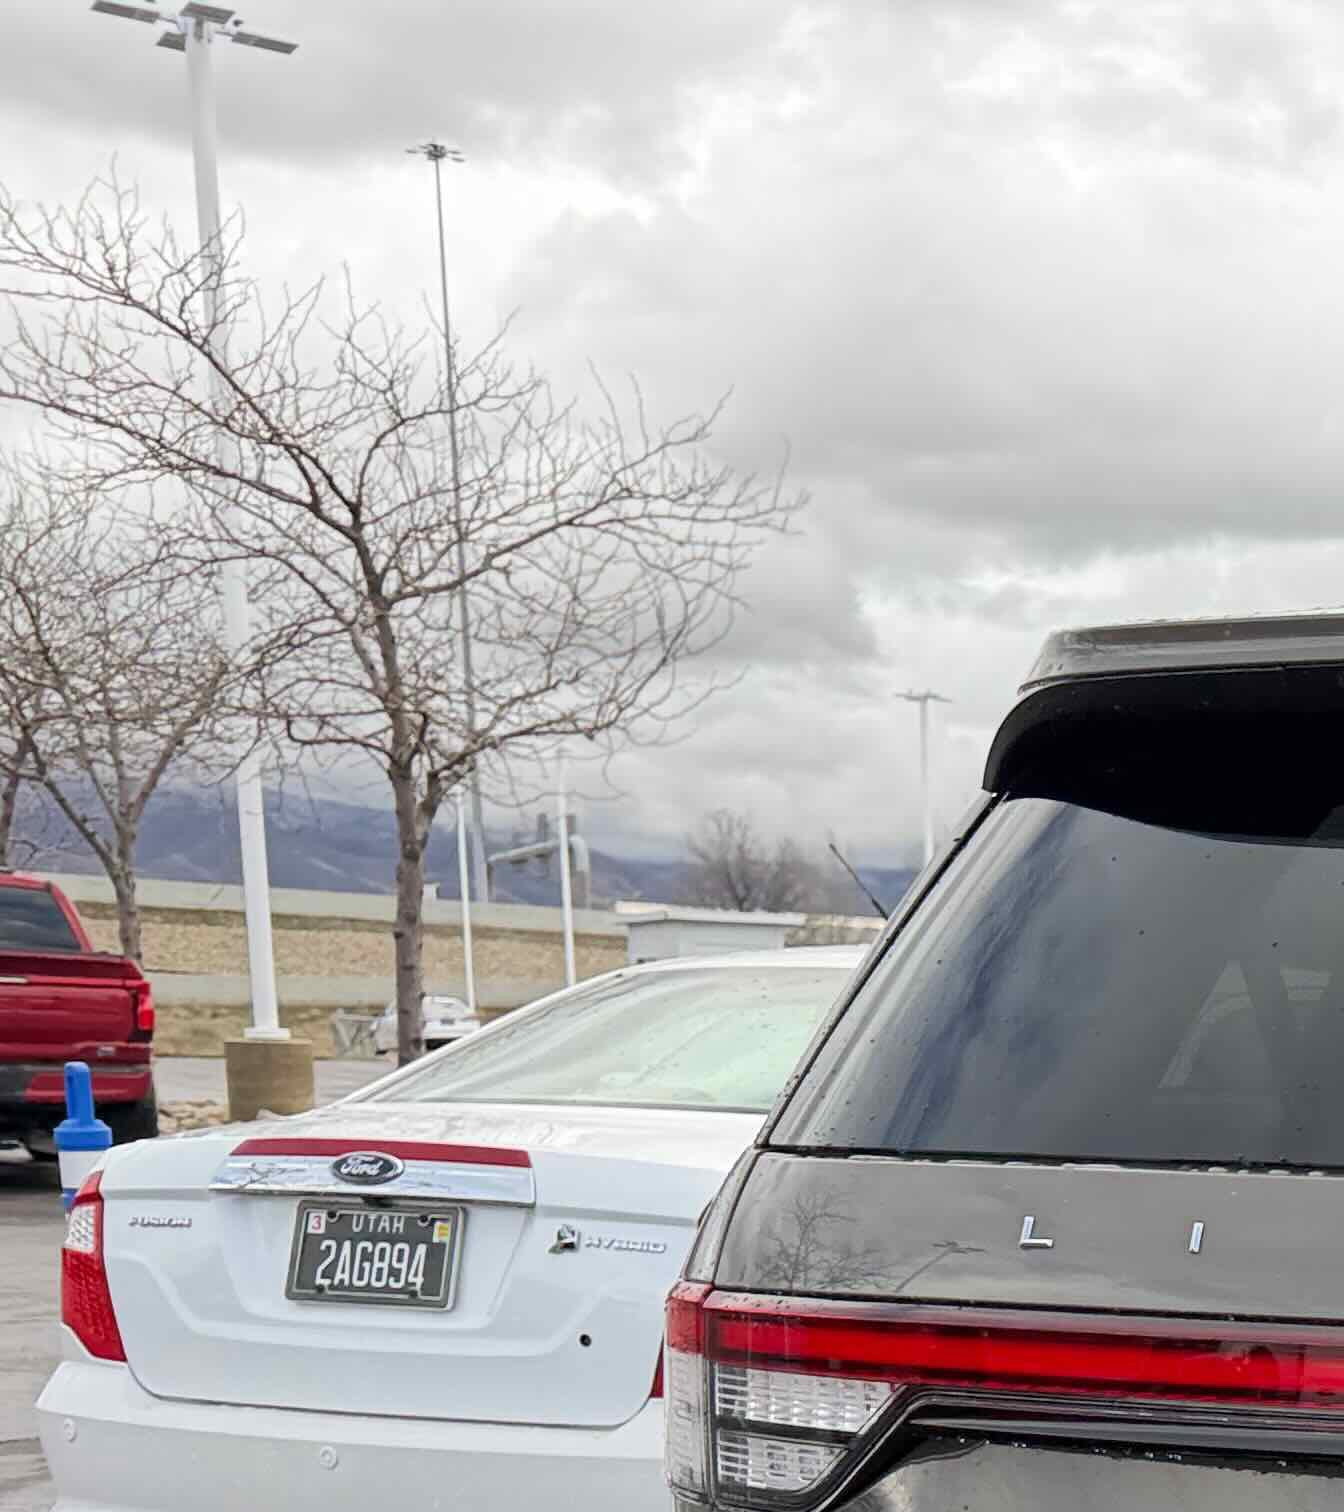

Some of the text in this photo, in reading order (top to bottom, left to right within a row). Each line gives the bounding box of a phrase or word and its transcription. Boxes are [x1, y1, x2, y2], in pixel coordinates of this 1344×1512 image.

[340, 1155, 384, 1176] Ford
[351, 1213, 405, 1233] UTAH
[315, 1239, 428, 1288] 2AG894
